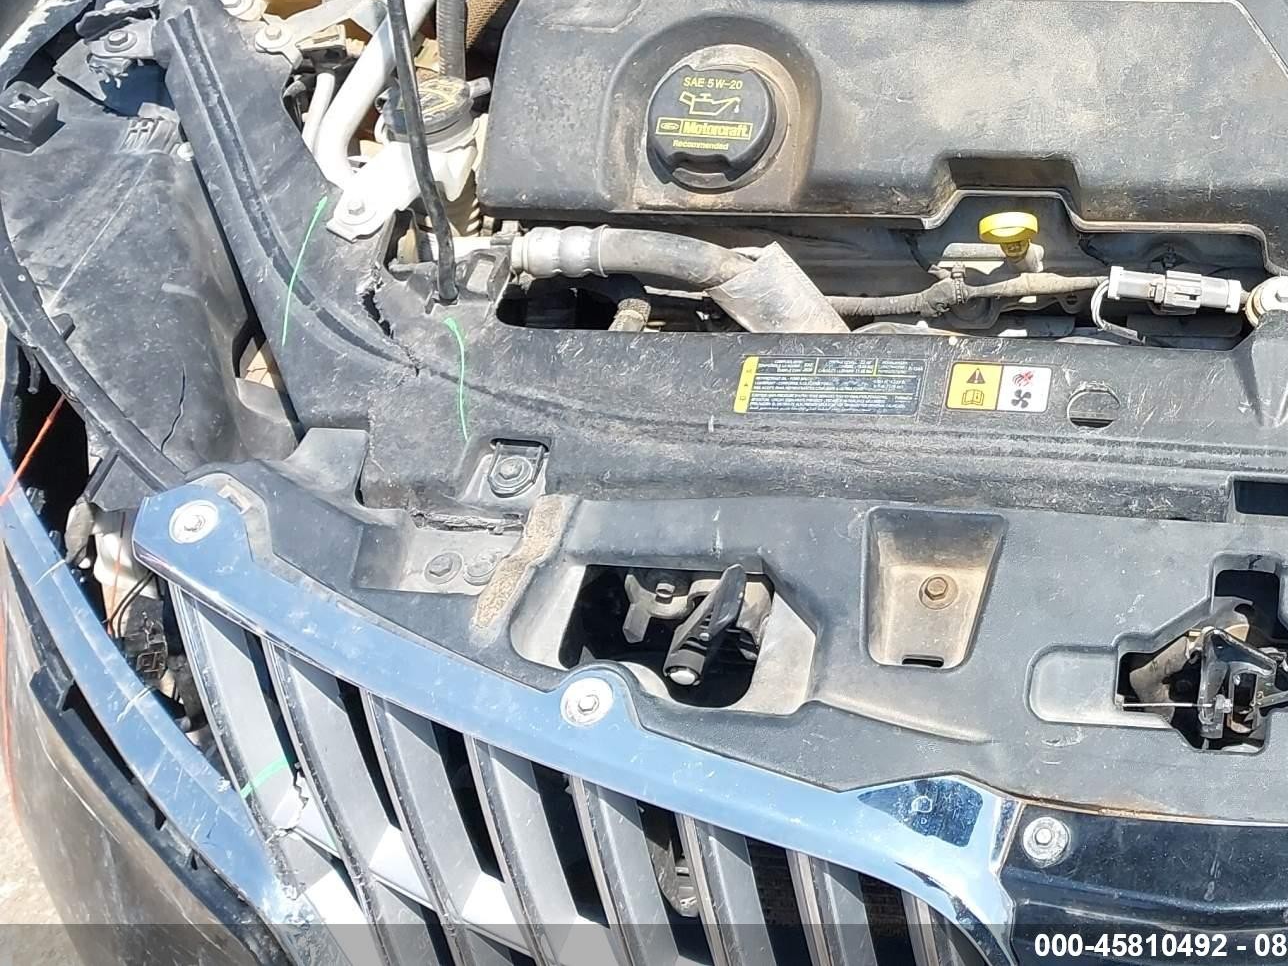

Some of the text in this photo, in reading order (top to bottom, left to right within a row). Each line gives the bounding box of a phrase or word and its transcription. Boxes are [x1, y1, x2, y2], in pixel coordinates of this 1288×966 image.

[683, 77, 743, 90] SAE 5W-20
[672, 139, 729, 151] Recommended
